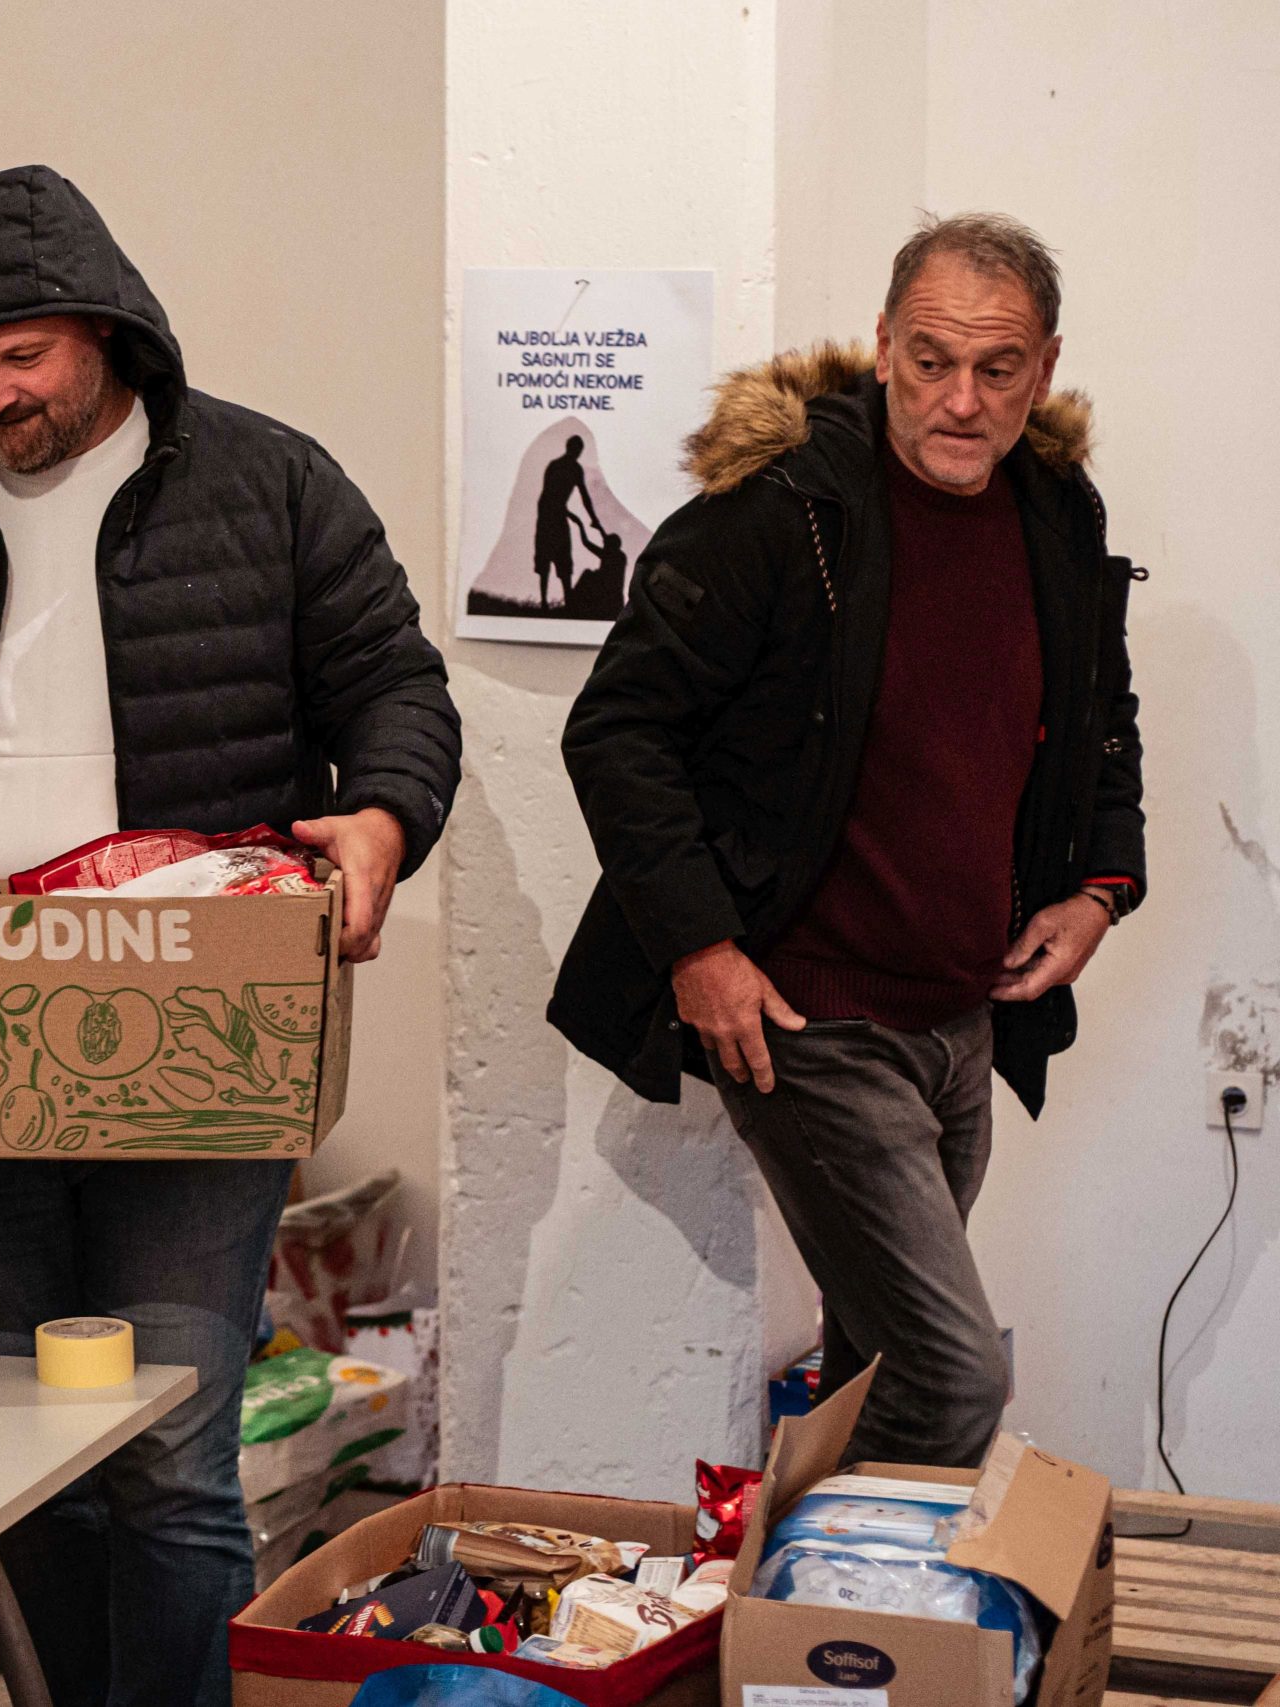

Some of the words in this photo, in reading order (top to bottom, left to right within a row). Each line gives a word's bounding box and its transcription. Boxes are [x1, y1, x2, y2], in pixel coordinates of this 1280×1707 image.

[498, 1331, 580, 1346] NAJBOLJA
[584, 1328, 648, 1347] VJEŽBA
[521, 1352, 590, 1367] SAGNUTI
[595, 1353, 616, 1368] SE
[498, 1373, 502, 1387] I
[506, 1370, 569, 1388] POMOĆI
[574, 1374, 644, 1390] NEKOME
[522, 1394, 543, 1409] DA
[548, 1395, 615, 1410] USTANE.
[823, 1651, 880, 1670] Soffisof
